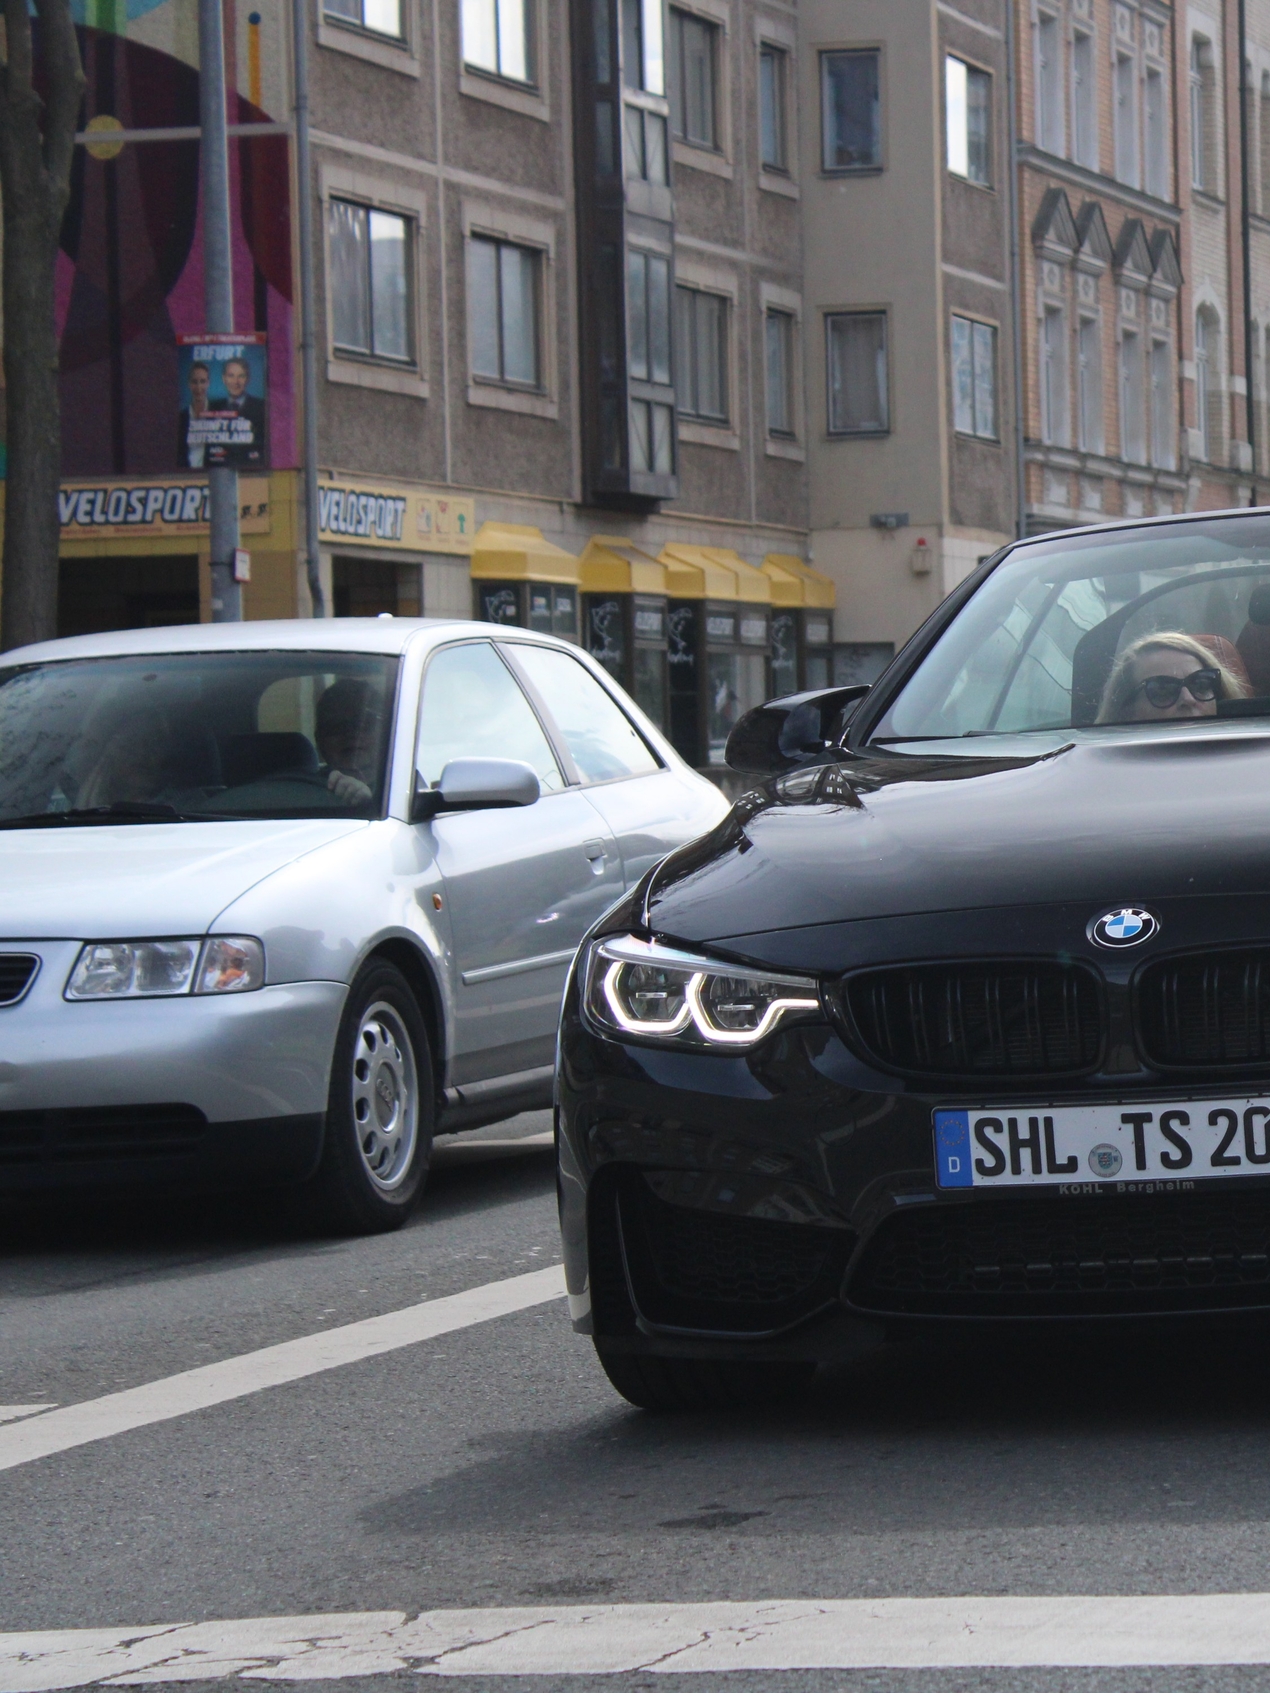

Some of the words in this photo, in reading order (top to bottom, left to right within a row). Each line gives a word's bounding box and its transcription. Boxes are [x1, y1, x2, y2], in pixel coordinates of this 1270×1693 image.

[193, 345, 244, 361] ERFURT
[187, 431, 254, 444] DEUTSCHLAND
[318, 486, 406, 541] VELOSPORT
[1102, 908, 1152, 922] BMW
[948, 1156, 961, 1174] D
[973, 1115, 1079, 1177] SHL
[1120, 1109, 1194, 1171] TS
[1116, 1180, 1195, 1193] Bergheim
